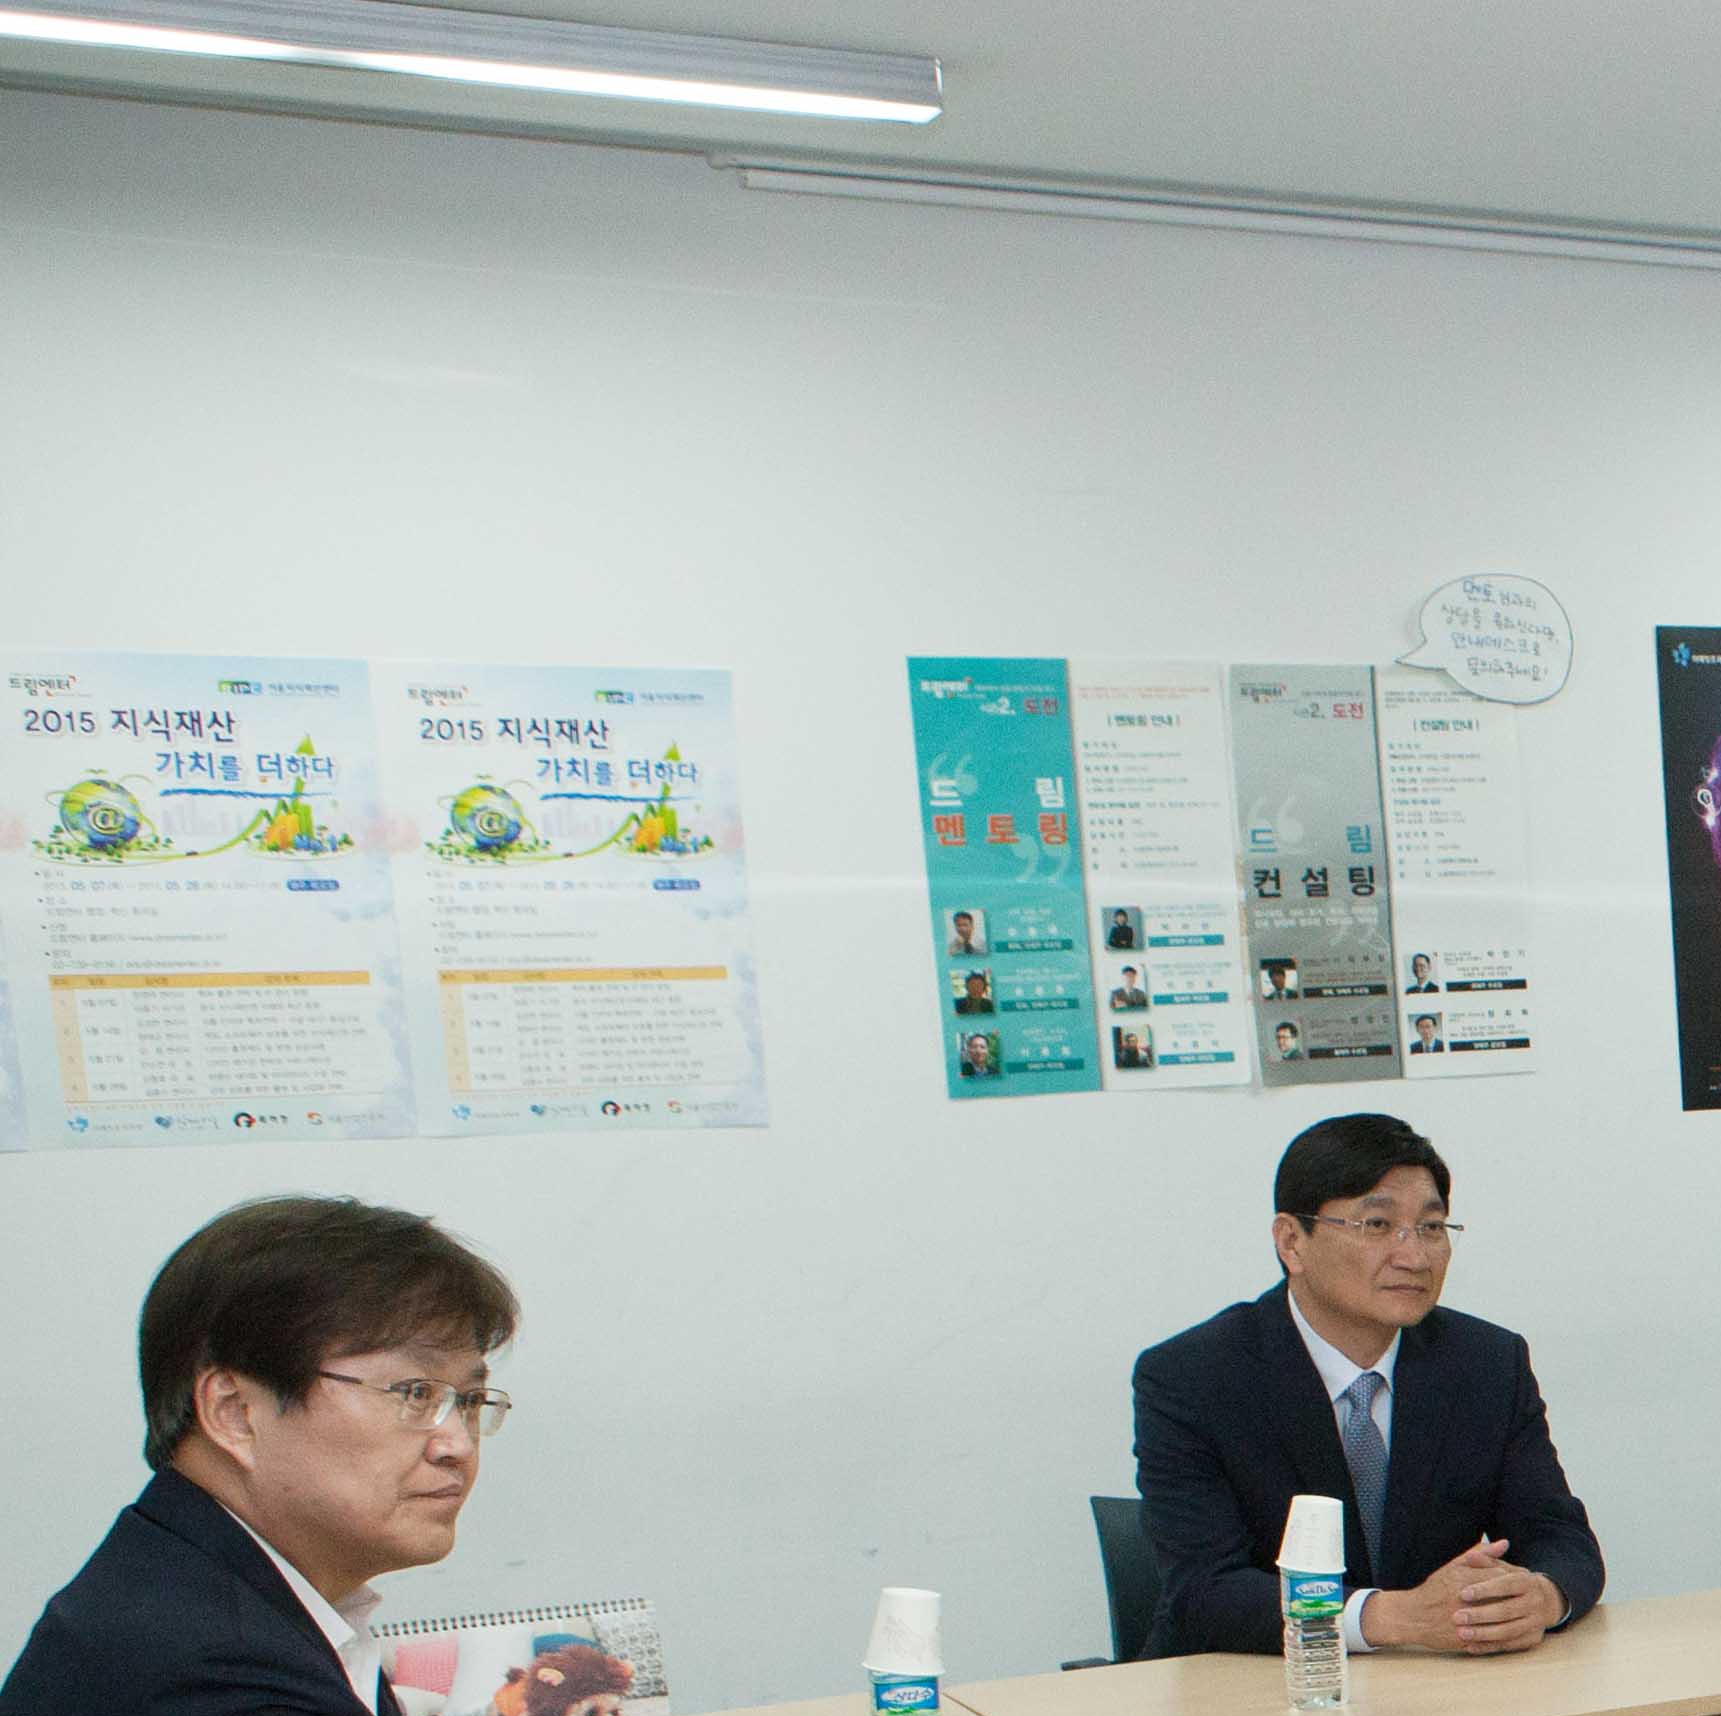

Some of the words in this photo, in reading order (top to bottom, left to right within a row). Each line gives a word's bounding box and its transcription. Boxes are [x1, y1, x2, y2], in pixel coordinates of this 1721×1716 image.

[24, 710, 97, 734] 2015
[110, 708, 236, 743] 지식재산
[1333, 703, 1364, 719] 도전
[419, 718, 484, 741] 2015
[498, 716, 609, 750] 지식재산
[155, 750, 242, 782] 가치를
[256, 752, 335, 780] 더하다
[537, 757, 614, 787] 가치를
[627, 758, 698, 784] 더하다
[933, 813, 1068, 846] 멘토링
[1253, 865, 1374, 898] 컨설팅
